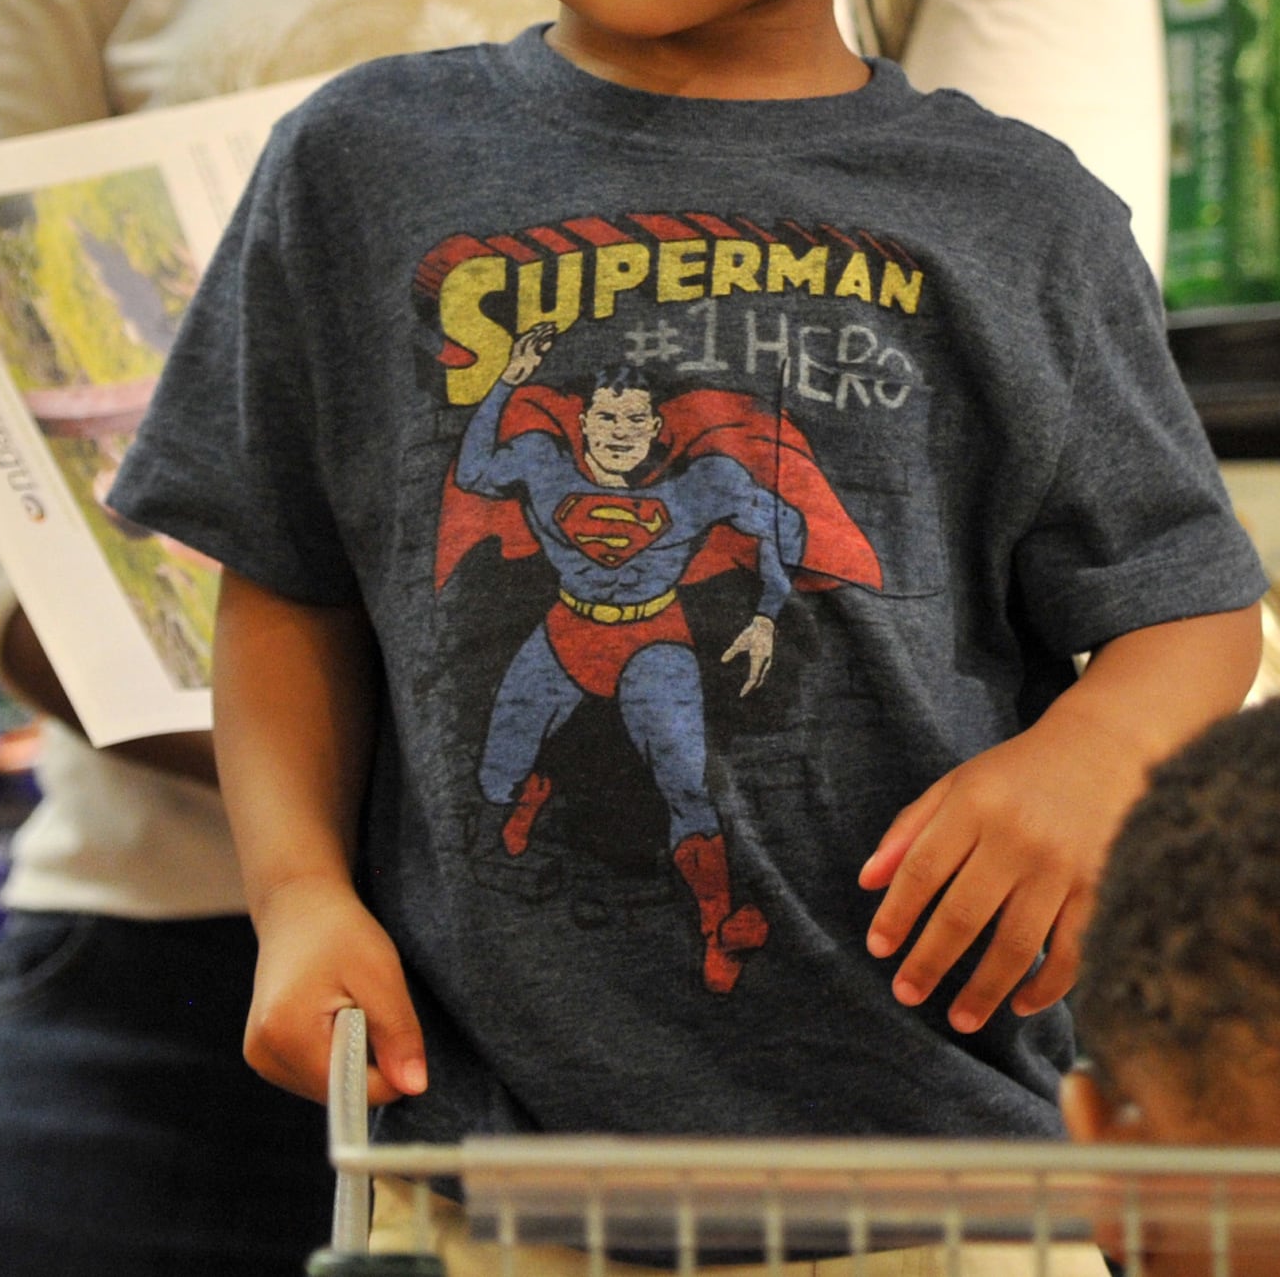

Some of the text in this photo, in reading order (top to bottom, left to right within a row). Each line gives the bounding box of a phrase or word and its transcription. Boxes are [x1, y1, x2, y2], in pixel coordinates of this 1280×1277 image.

[438, 239, 923, 405] SUPERMAN
[626, 299, 913, 410] #1 HERO
